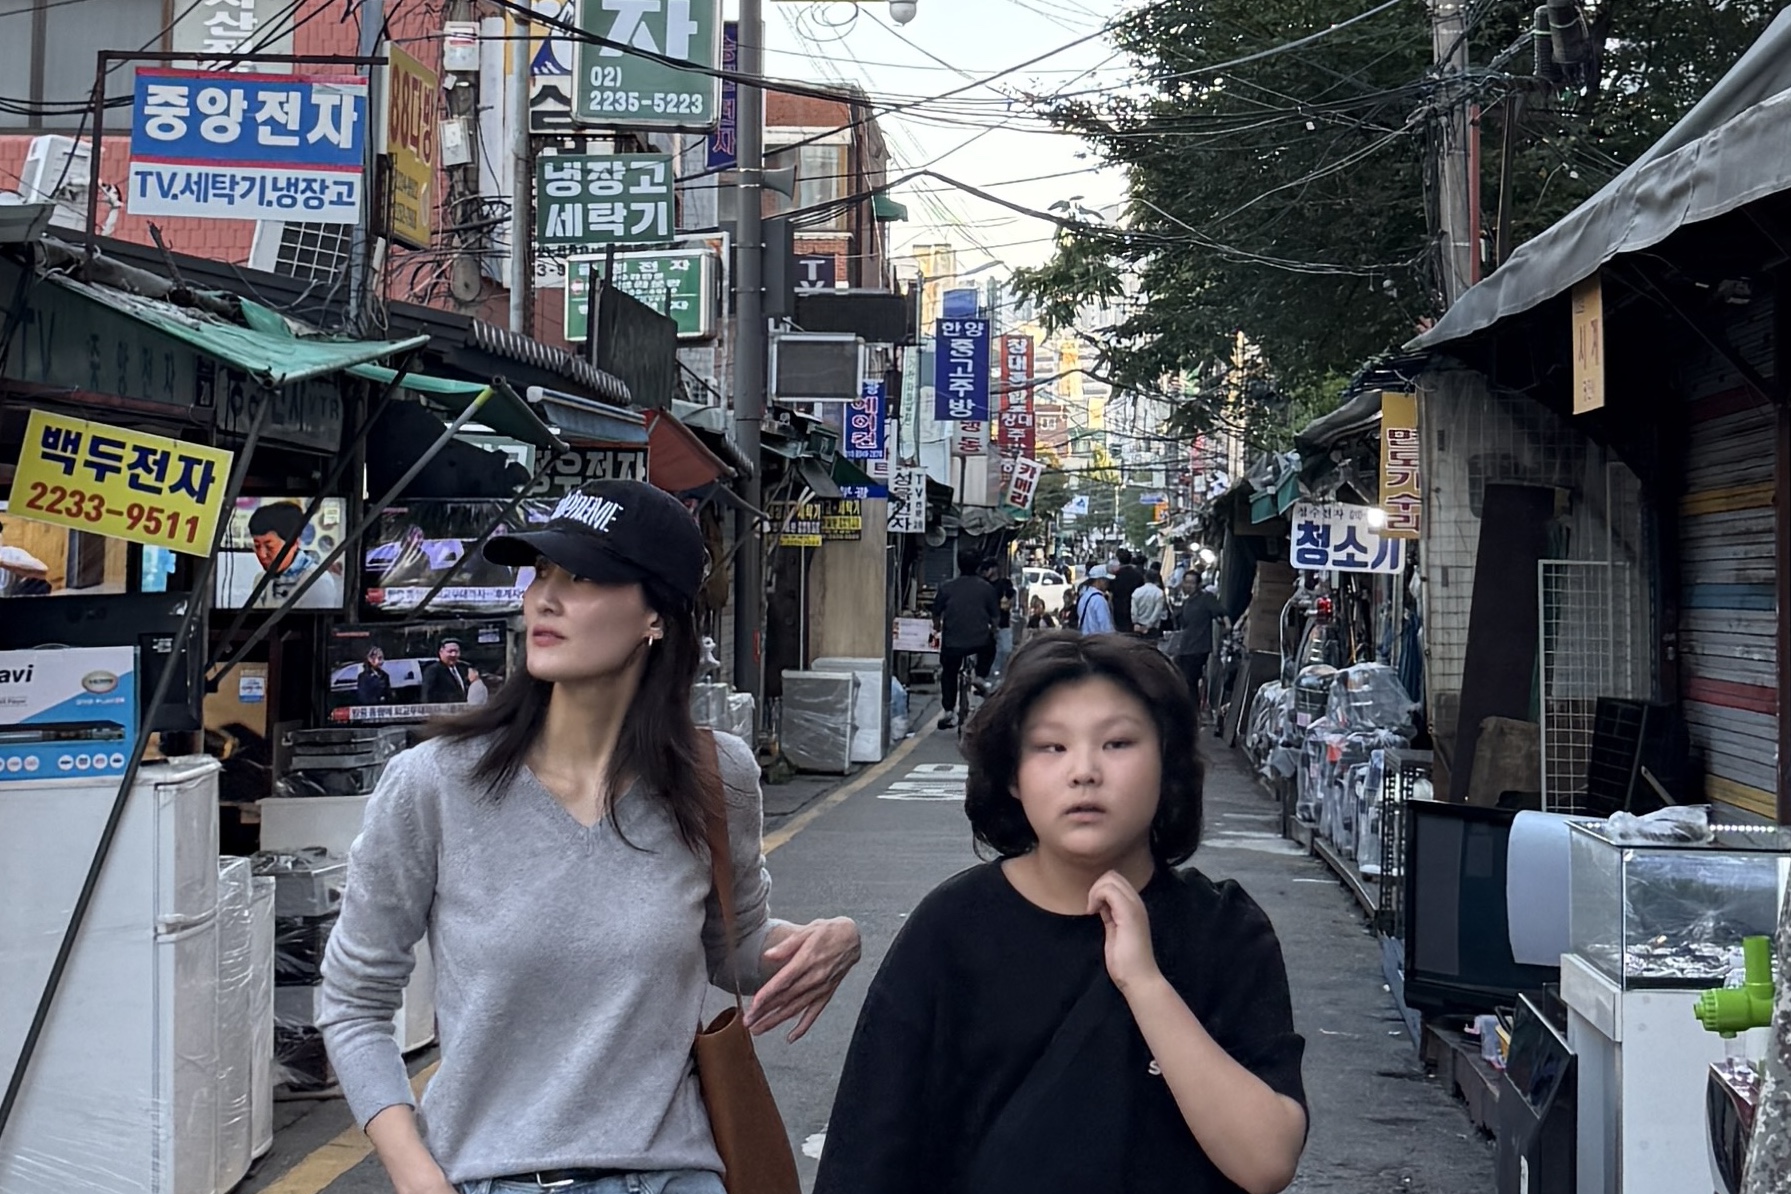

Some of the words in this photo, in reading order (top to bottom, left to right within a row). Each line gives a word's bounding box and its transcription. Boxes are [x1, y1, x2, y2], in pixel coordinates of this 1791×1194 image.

[590, 66, 622, 87] 02)
[144, 84, 357, 148] 중앙전자
[589, 90, 703, 114] 2235-5223
[134, 171, 356, 210] TV.세탁기.냉장고
[544, 161, 667, 196] 냉장고
[545, 202, 668, 237] 세탁기
[942, 322, 985, 337] 한양
[949, 338, 975, 418] 중고주방
[41, 425, 215, 505] 백두전자
[26, 481, 200, 543] 2233-9511
[1296, 520, 1401, 570] 청소기
